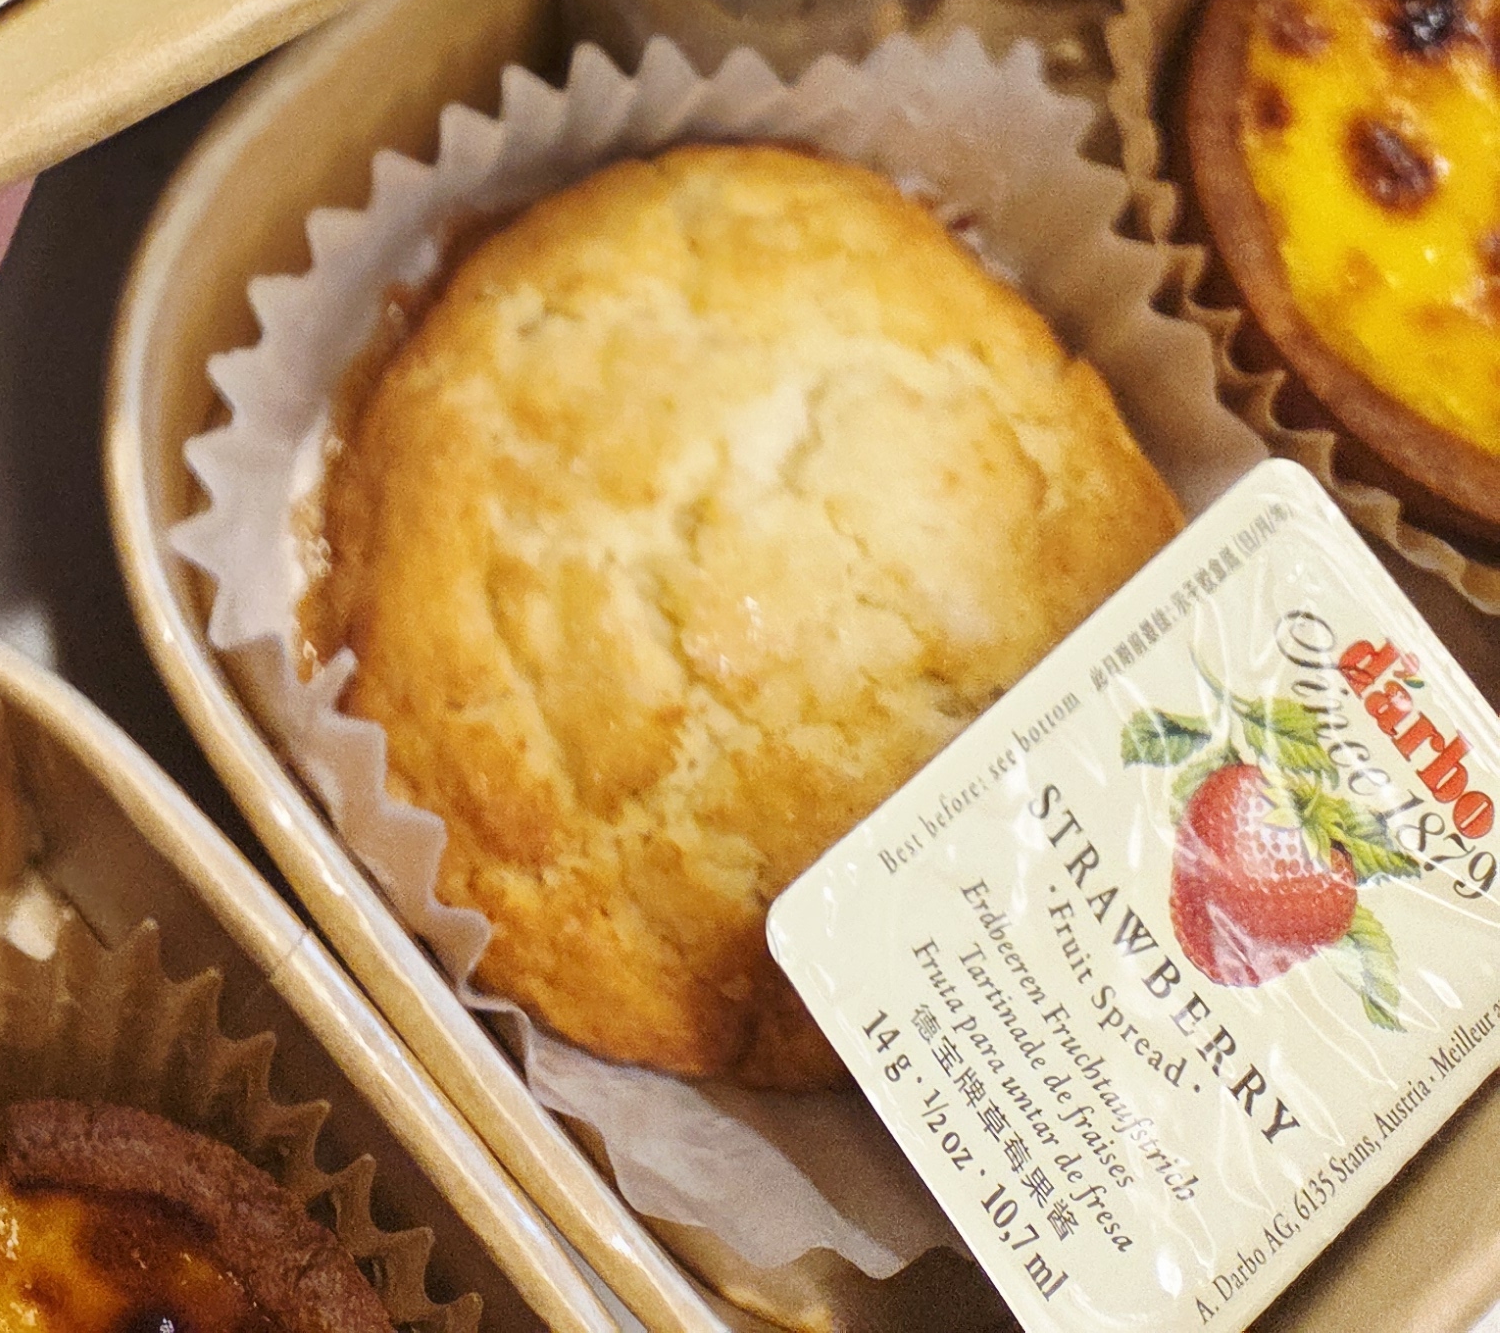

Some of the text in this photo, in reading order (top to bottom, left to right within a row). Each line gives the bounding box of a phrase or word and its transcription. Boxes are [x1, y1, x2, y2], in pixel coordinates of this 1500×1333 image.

[877, 692, 1082, 875] Best before: see bottom
[1374, 789, 1497, 899] 1879
[959, 943, 1134, 1188] Tartinade de fraises
[960, 878, 1199, 1201] Erdbeeren Fruchtaufstrich
[1028, 784, 1300, 1145] STRAWBERRY
[1048, 900, 1188, 1087] Fruit Spread
[911, 936, 1133, 1253] Fruta para untar de fresa
[911, 1004, 1079, 1241] 德宝牌草莓果酱
[1194, 1024, 1494, 1325] A. Darbo AG, 6135 Stans, Austria Meilleur
[980, 1183, 1041, 1251] 10,7
[1023, 1252, 1070, 1302] ml
